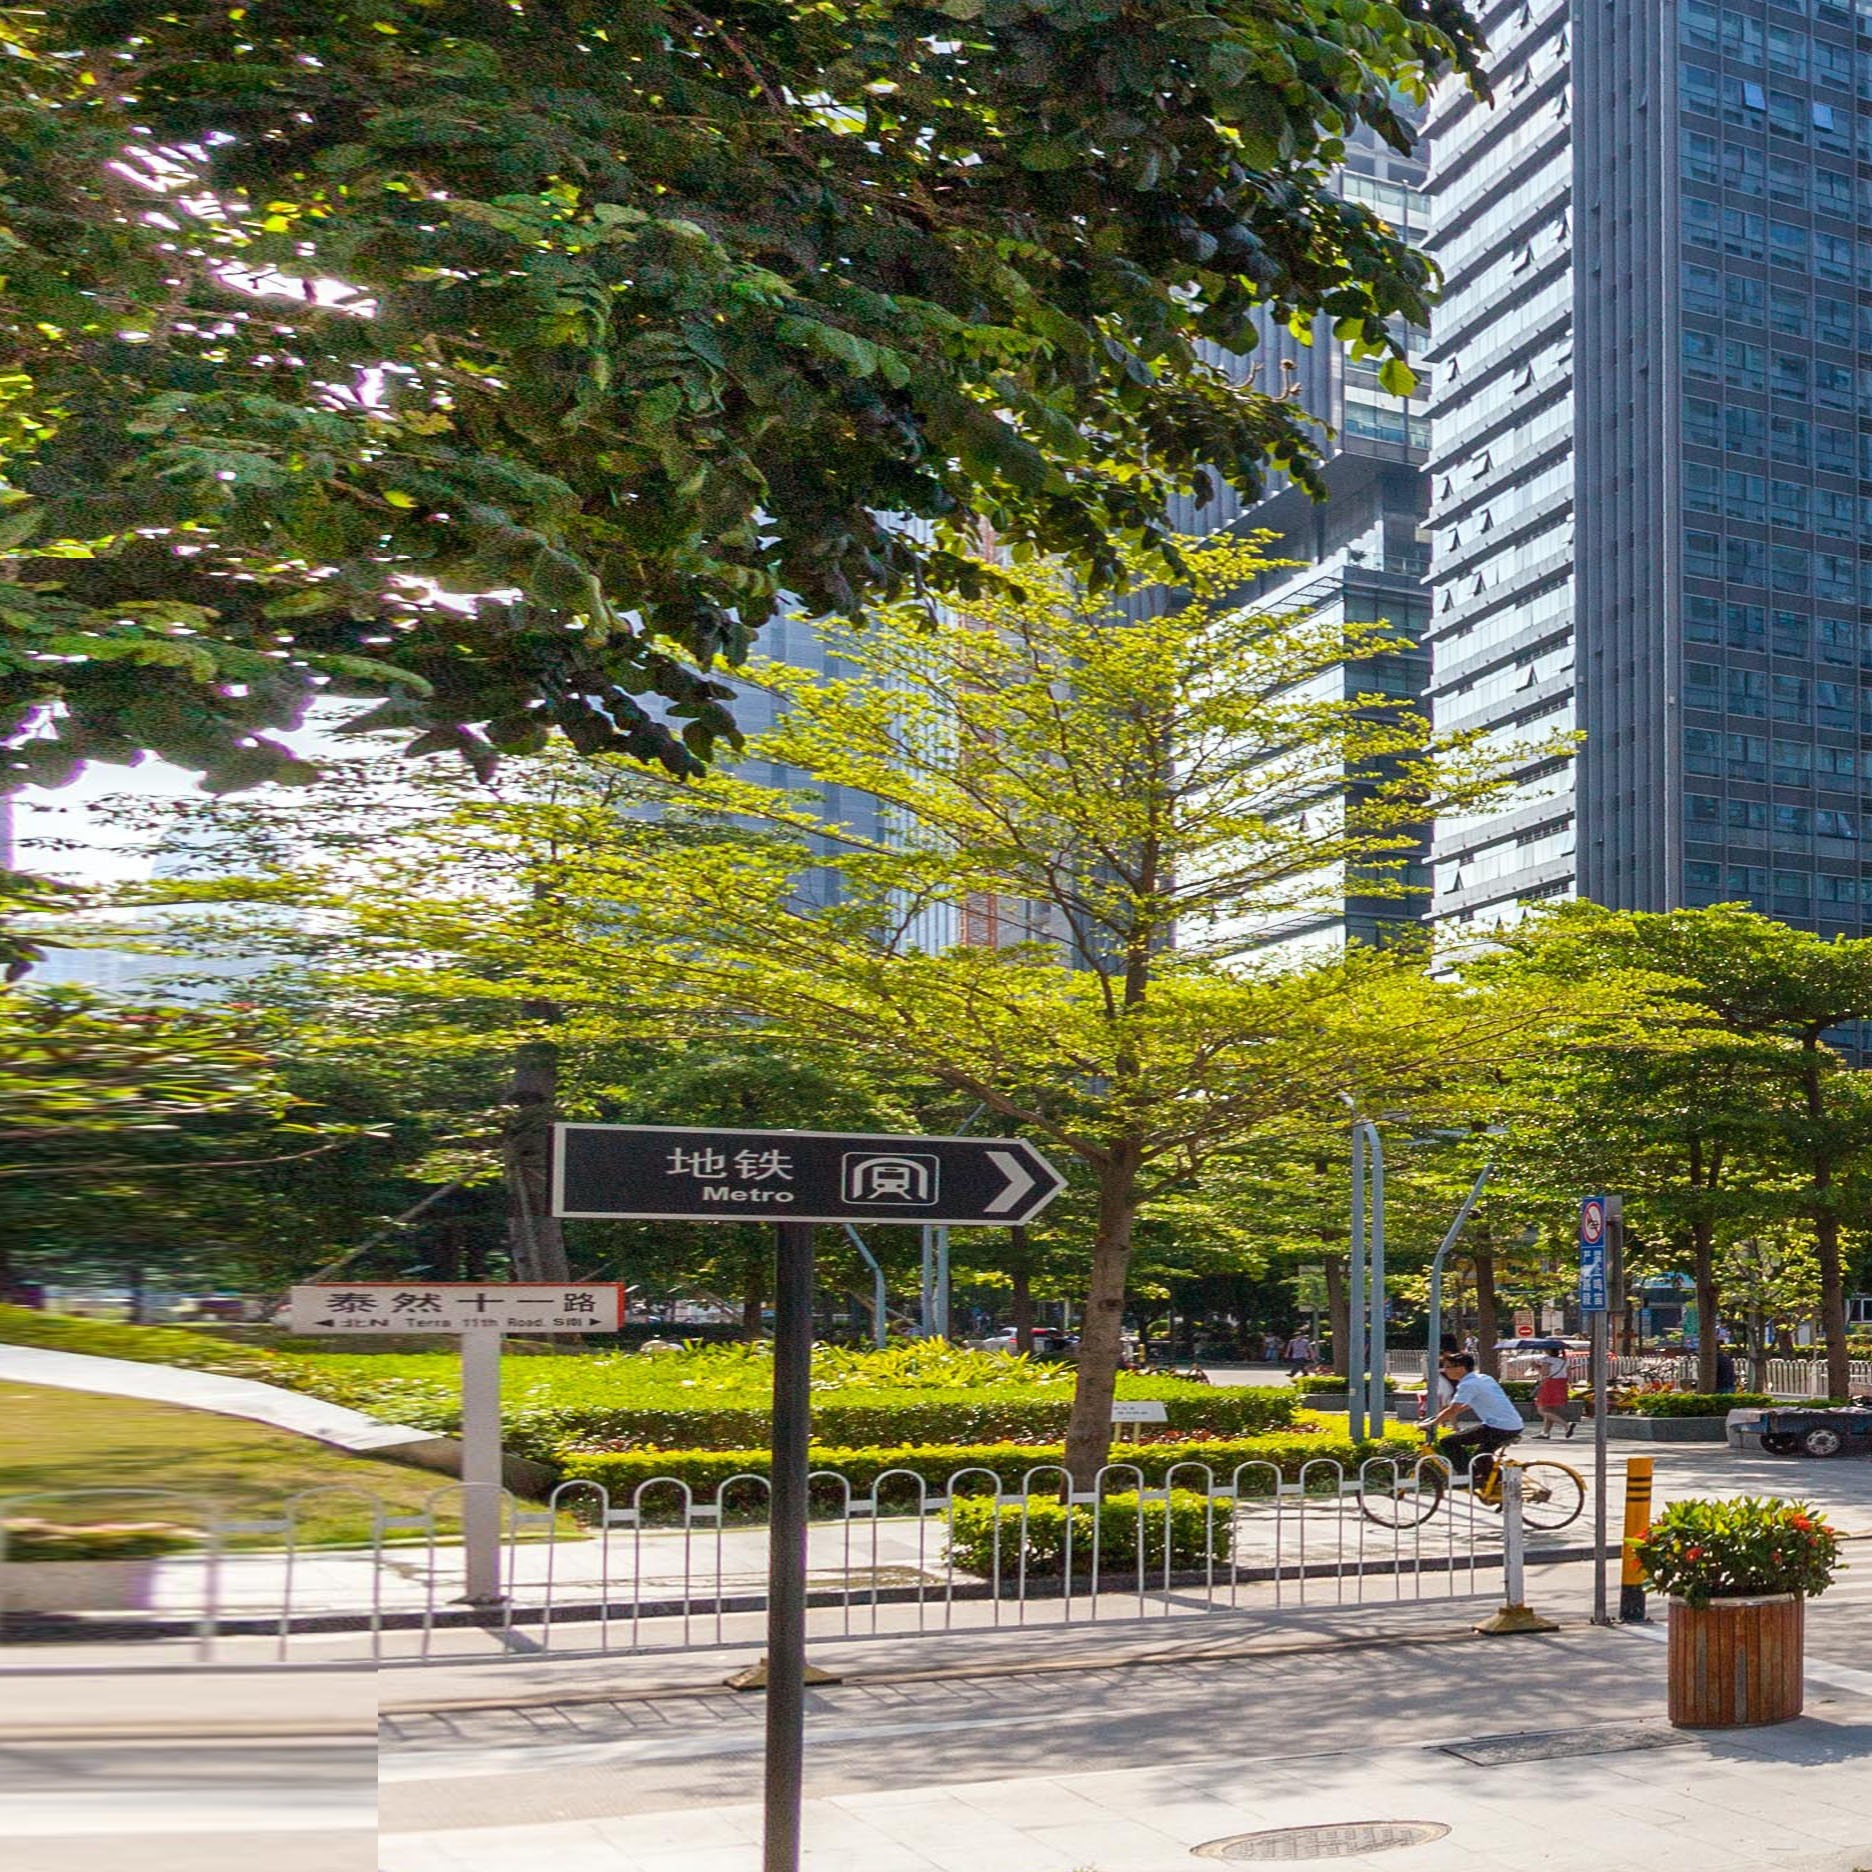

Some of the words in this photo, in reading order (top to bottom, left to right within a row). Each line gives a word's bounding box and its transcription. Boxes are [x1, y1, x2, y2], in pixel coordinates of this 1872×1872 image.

[666, 1147, 795, 1180] 地铁
[702, 1186, 795, 1203] Metro
[326, 1292, 597, 1313] 泰然十一路
[405, 1318, 451, 1328] Terra
[462, 1318, 497, 1328] 11th
